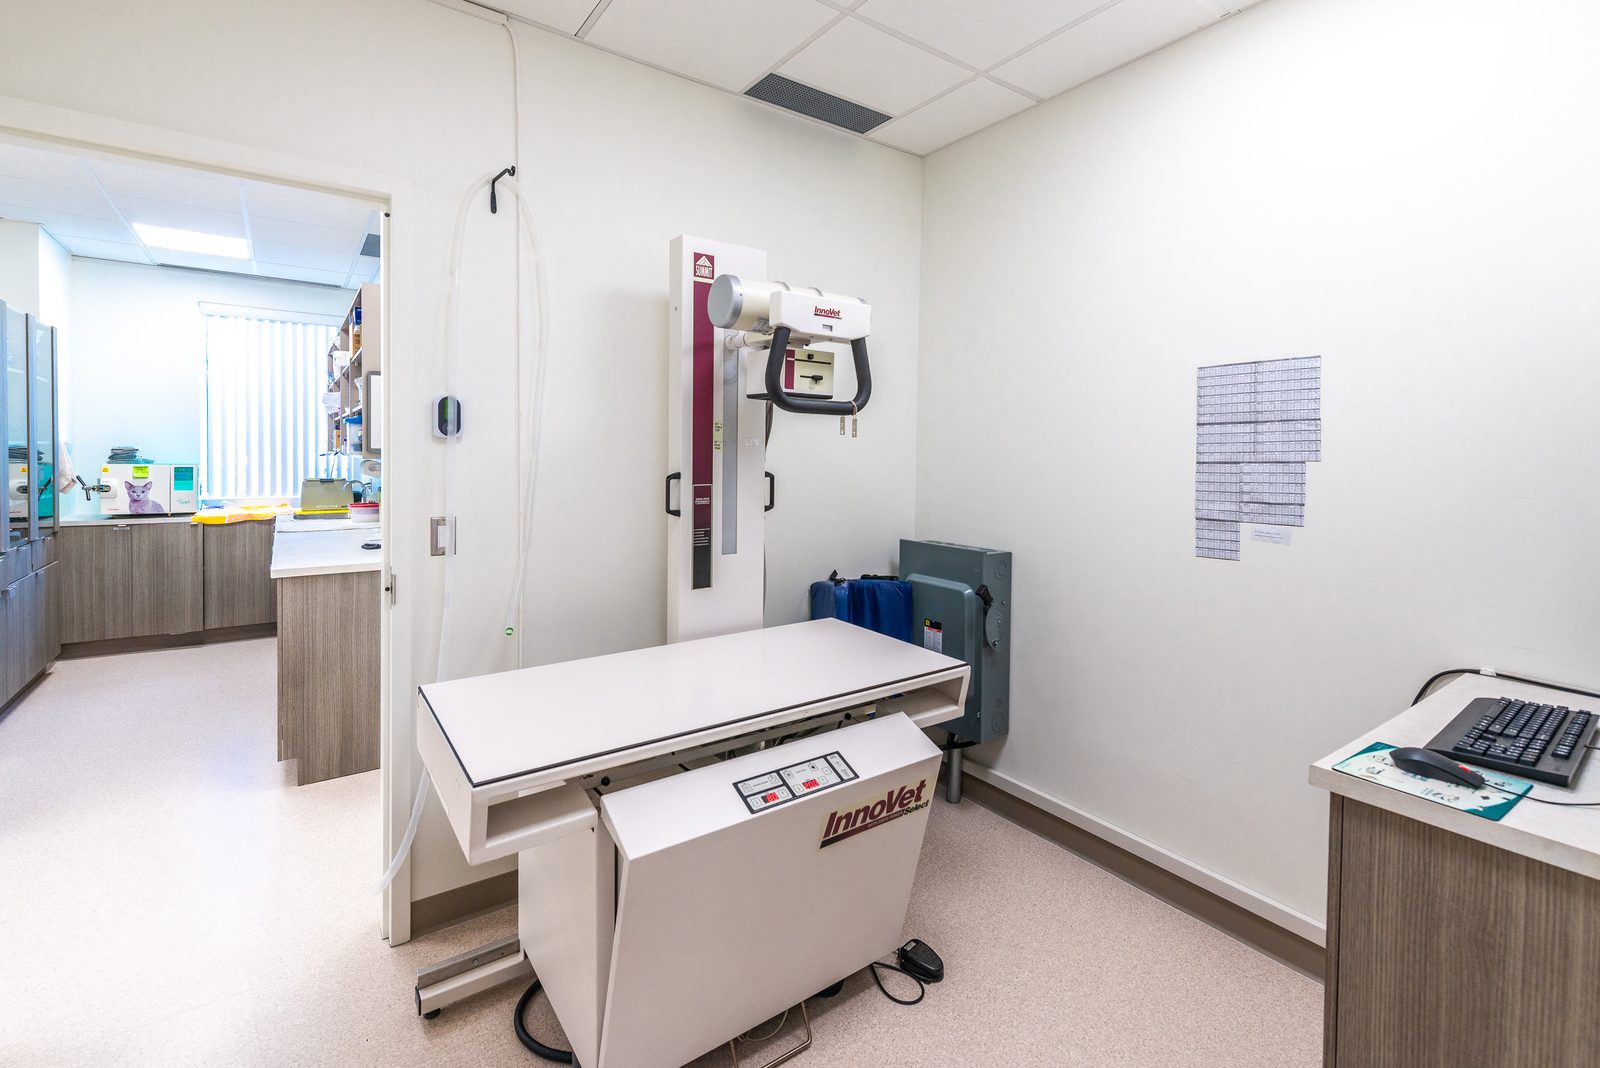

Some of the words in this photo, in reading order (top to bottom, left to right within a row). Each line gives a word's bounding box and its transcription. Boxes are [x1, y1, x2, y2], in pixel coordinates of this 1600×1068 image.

[696, 265, 712, 278] SUMMIT
[814, 306, 841, 317] InnoVet
[823, 779, 927, 839] InnoVet
[904, 800, 929, 815] Select
